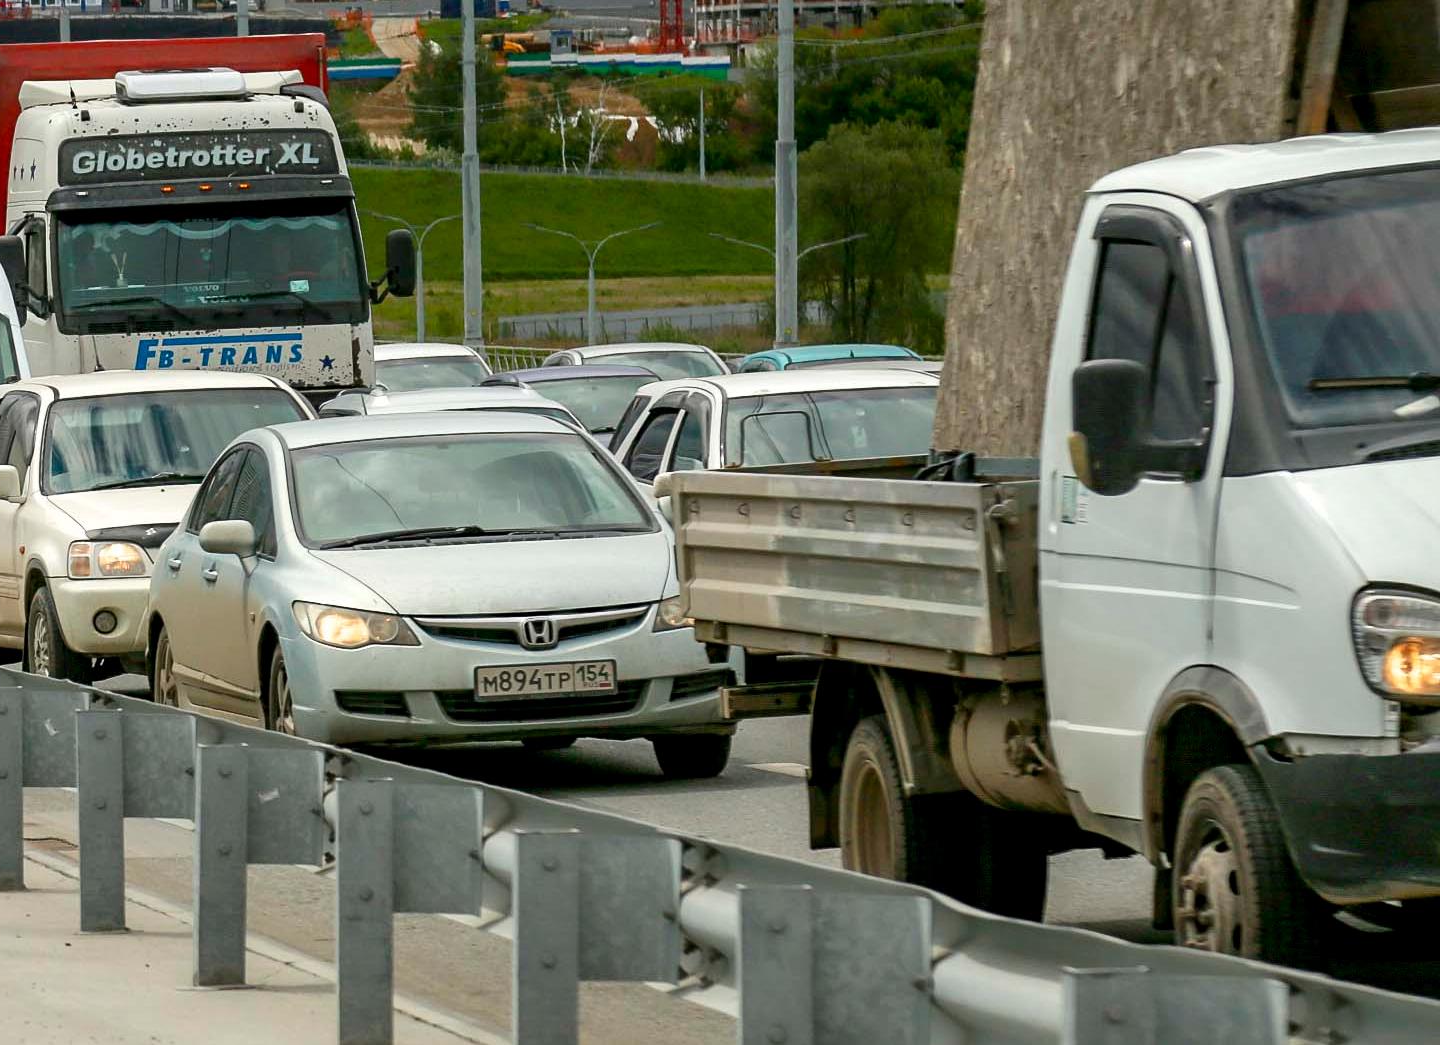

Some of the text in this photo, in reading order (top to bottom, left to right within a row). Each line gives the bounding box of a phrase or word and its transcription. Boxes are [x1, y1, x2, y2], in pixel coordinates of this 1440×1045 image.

[72, 142, 320, 174] Globetrotter XL
[576, 664, 609, 682] 154
